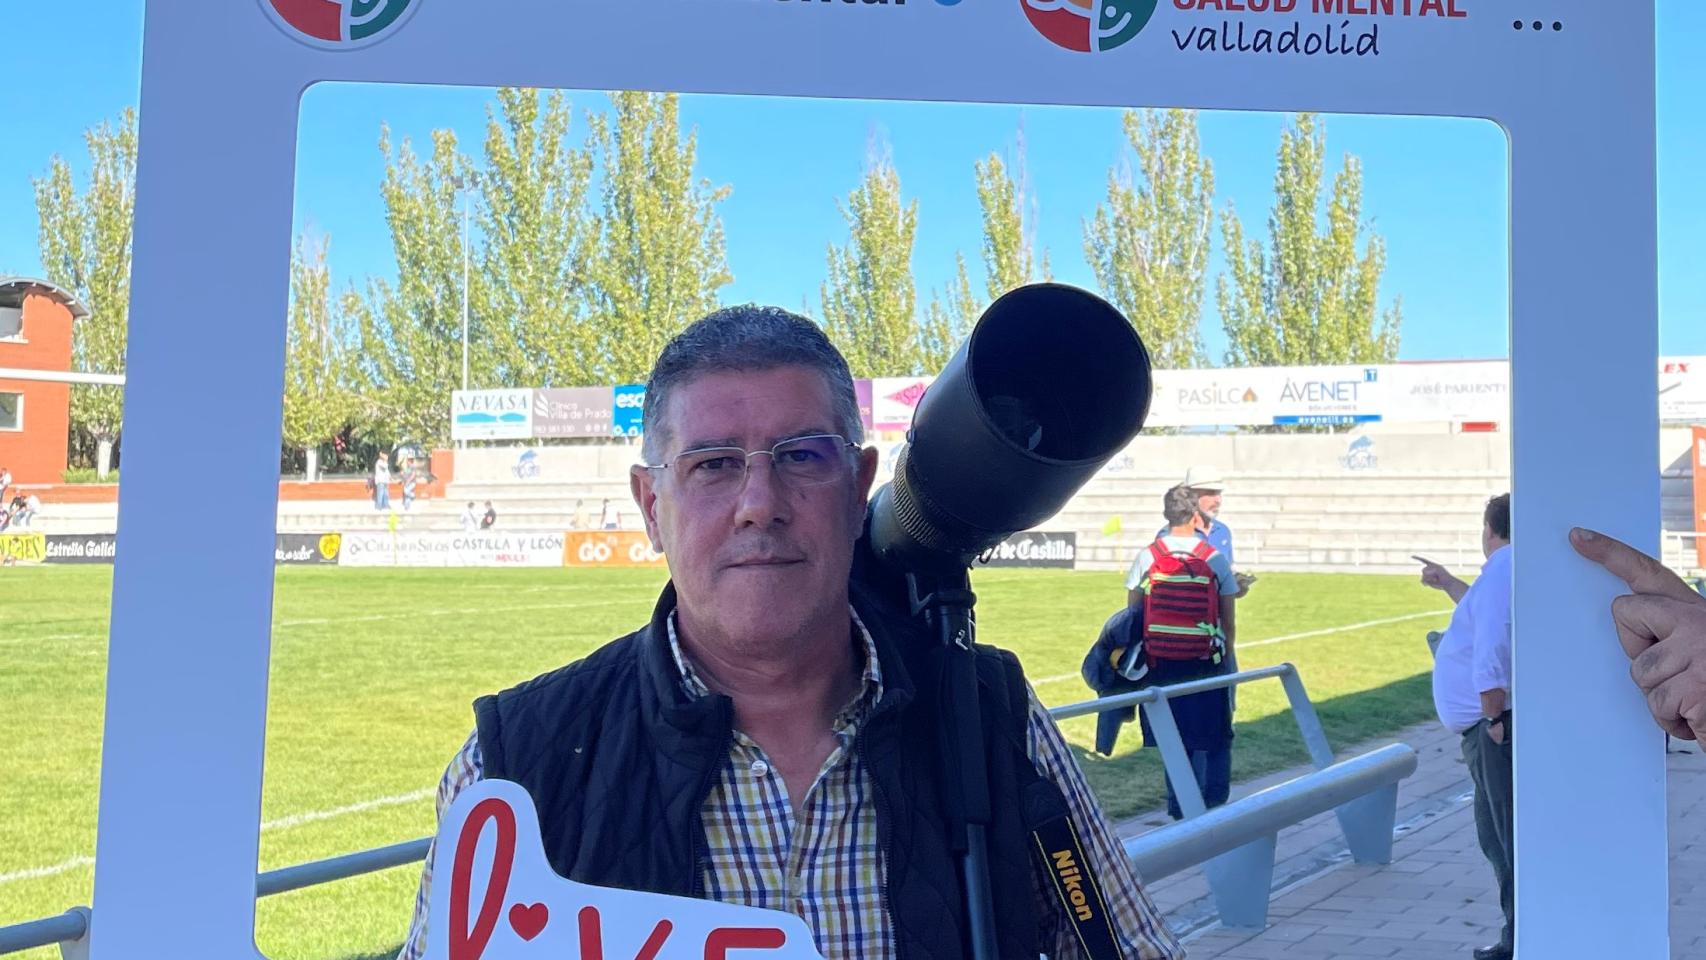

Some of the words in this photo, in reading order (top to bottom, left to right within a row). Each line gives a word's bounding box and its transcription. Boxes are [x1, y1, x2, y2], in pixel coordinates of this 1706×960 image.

[457, 394, 527, 411] NEVASA
[46, 540, 84, 557] Estrella
[453, 537, 511, 551] CASTILLA
[517, 538, 527, 552] Y
[530, 534, 563, 550] LEÓN
[578, 542, 612, 562] GO
[1016, 538, 1075, 560] Castilla
[1051, 848, 1094, 921] Nikon
